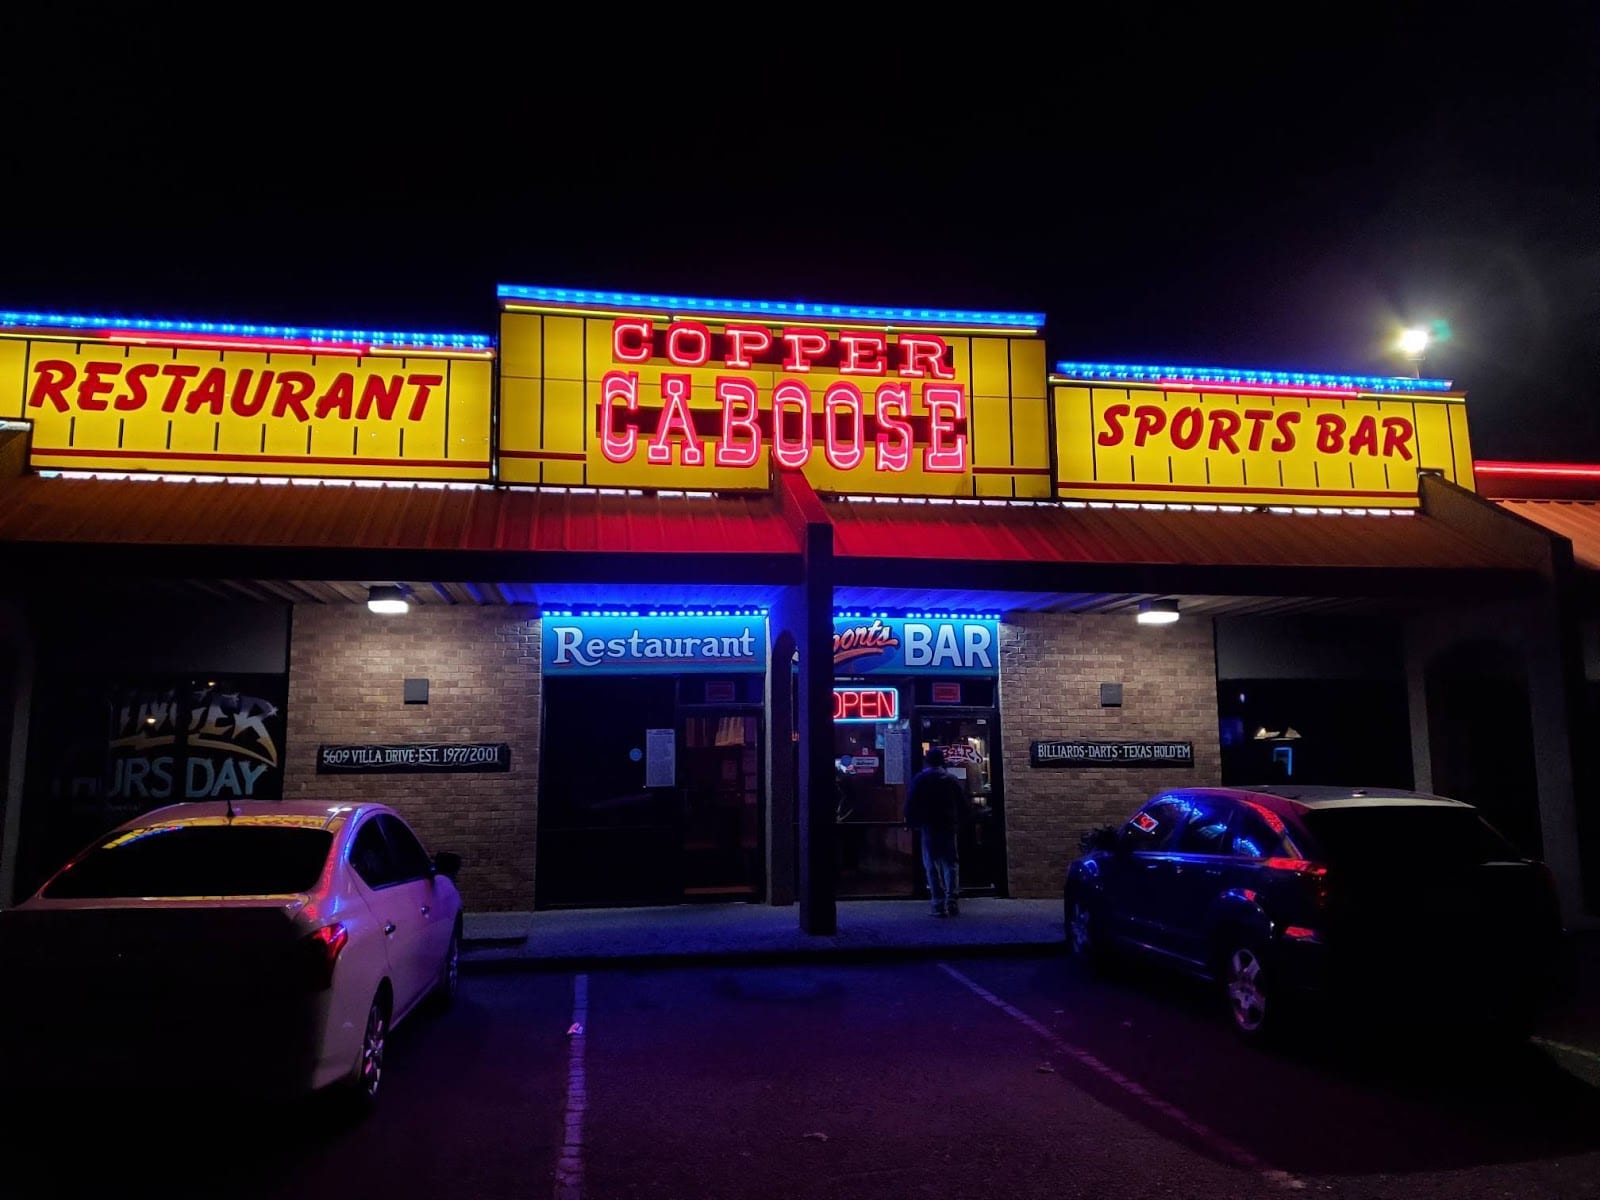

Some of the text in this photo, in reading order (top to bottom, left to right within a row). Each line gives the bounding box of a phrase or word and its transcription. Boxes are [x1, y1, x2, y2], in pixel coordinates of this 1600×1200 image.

[612, 317, 956, 379] COPPER
[28, 359, 443, 423] RESTAURANT
[600, 371, 967, 473] CABOOSE
[1098, 404, 1414, 460] SPORTS BAR
[552, 626, 757, 666] Restaurant
[903, 623, 993, 668] BAR
[185, 756, 269, 798] DAY
[323, 749, 350, 763] 5609
[351, 749, 383, 763] VILLA
[443, 747, 499, 763] 1977/2001
